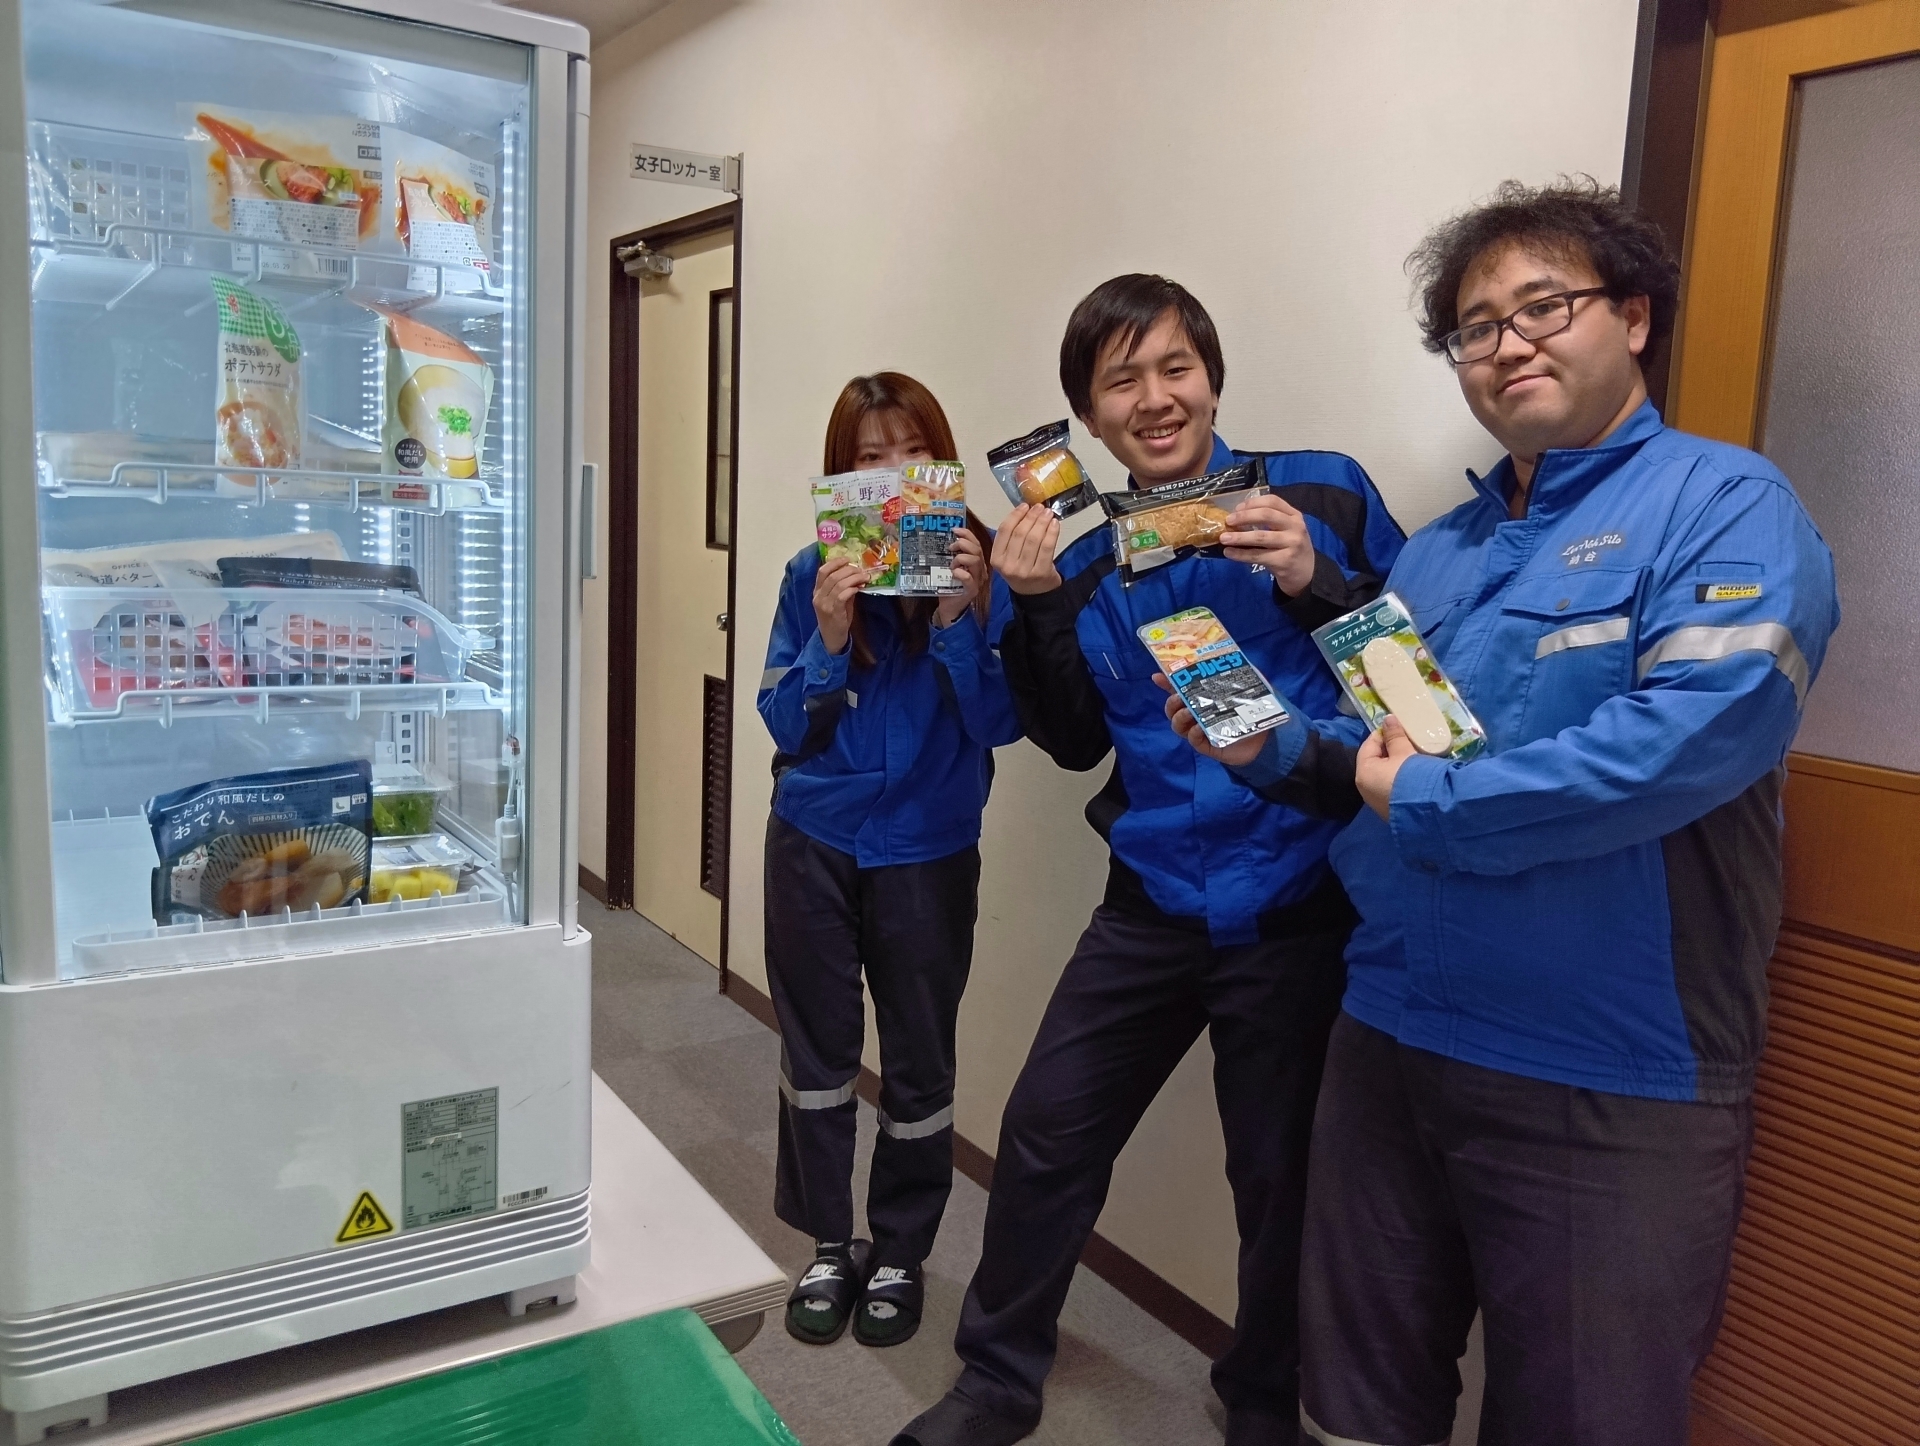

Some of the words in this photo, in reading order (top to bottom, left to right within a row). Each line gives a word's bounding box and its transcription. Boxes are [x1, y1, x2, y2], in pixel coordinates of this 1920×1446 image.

[635, 154, 721, 181] 女子ロッカー室
[225, 358, 282, 378] ポテトサラダ
[830, 483, 891, 507] 蒸し野菜
[902, 515, 962, 532] ロールピザ
[112, 562, 141, 571] OFFICE
[1251, 563, 1266, 574] Ze
[1331, 621, 1375, 647] サラダチキン
[1172, 652, 1243, 687] ロールピザ
[171, 792, 286, 825] こだわり和風だしの
[173, 808, 235, 840] おでん
[807, 1263, 838, 1277] NIKE
[874, 1266, 907, 1281] NIKE
